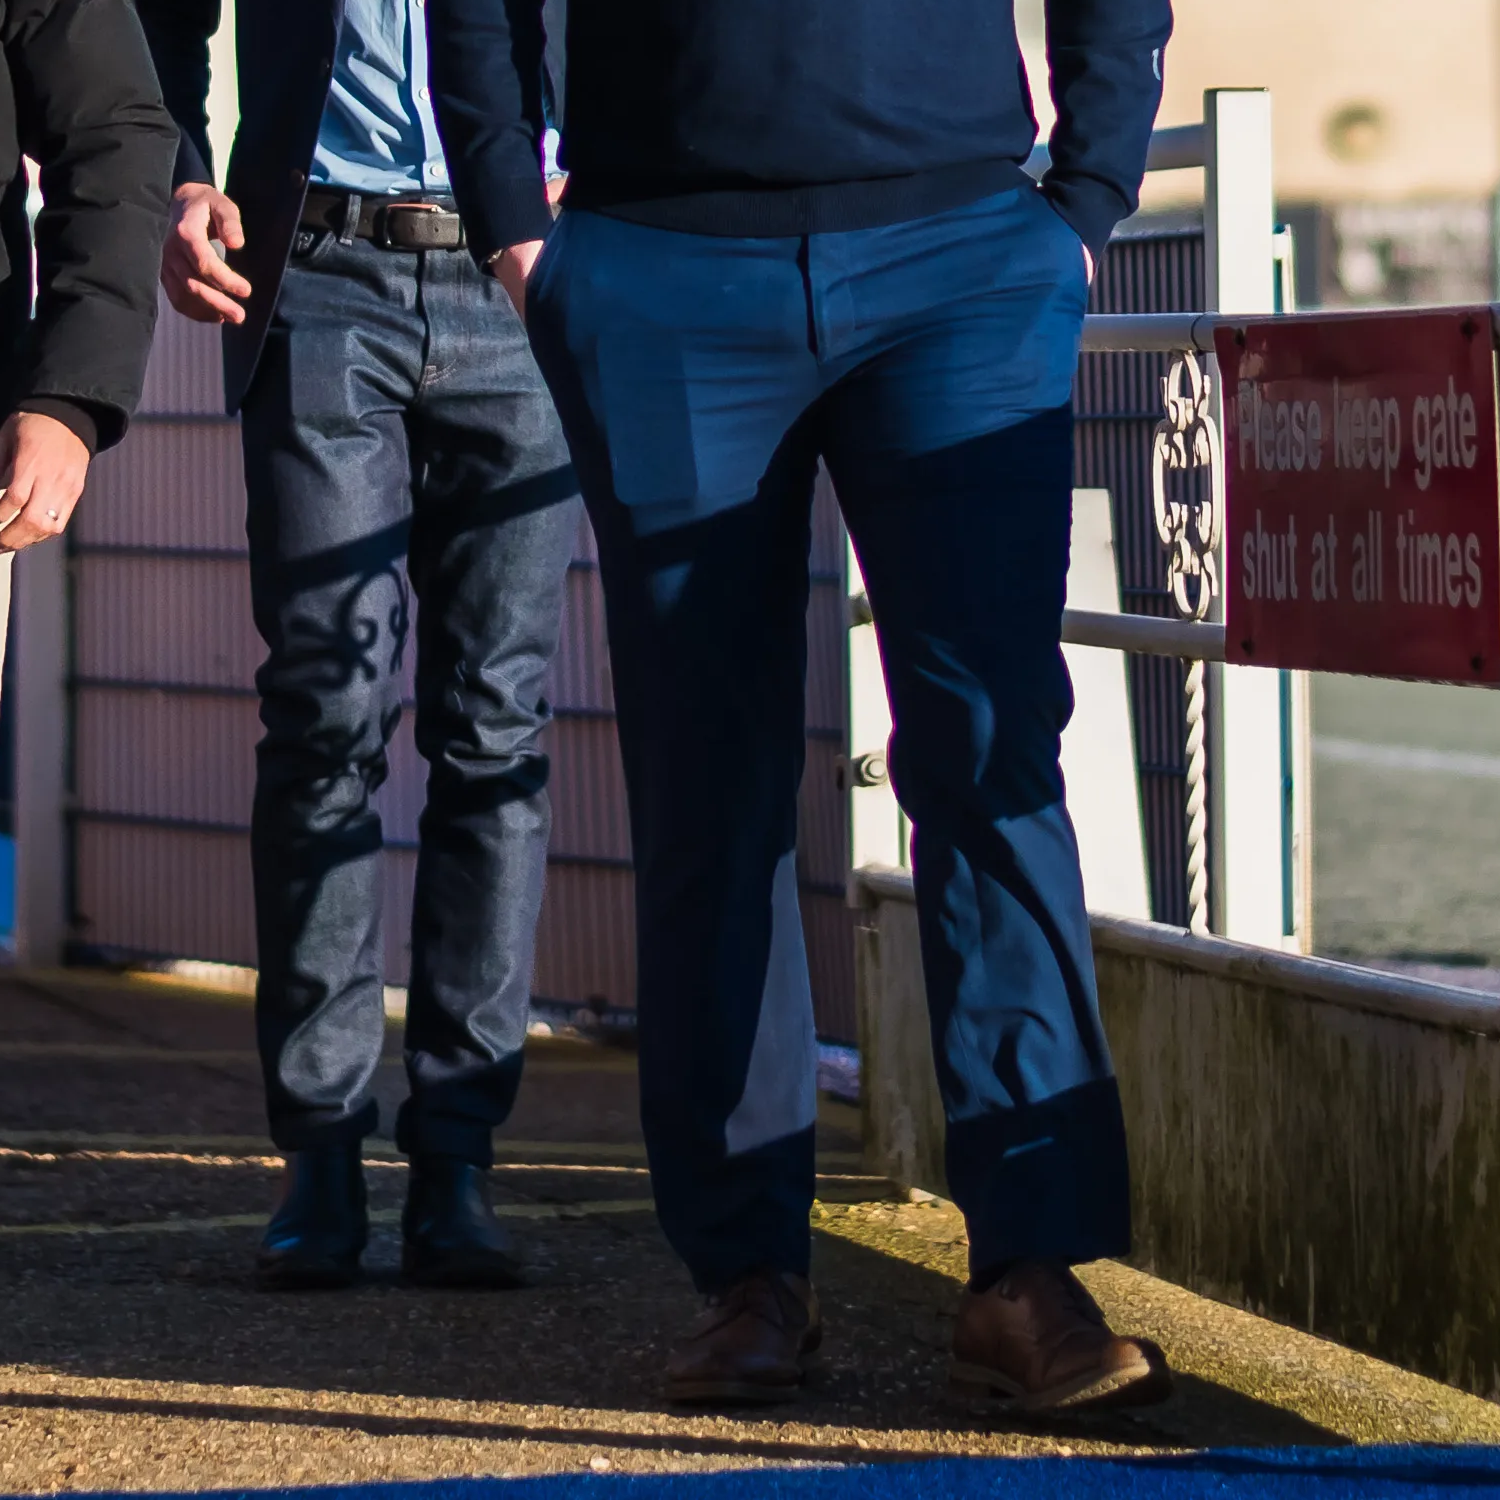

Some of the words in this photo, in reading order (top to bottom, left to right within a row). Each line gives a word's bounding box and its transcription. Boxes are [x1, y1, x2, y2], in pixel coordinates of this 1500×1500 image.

[1237, 379, 1323, 472] Please
[1332, 376, 1400, 490] keep
[1412, 374, 1478, 491] gate
[1241, 509, 1298, 601] shut
[1311, 514, 1339, 602] at
[1351, 509, 1384, 603] all
[1396, 509, 1483, 609] times
